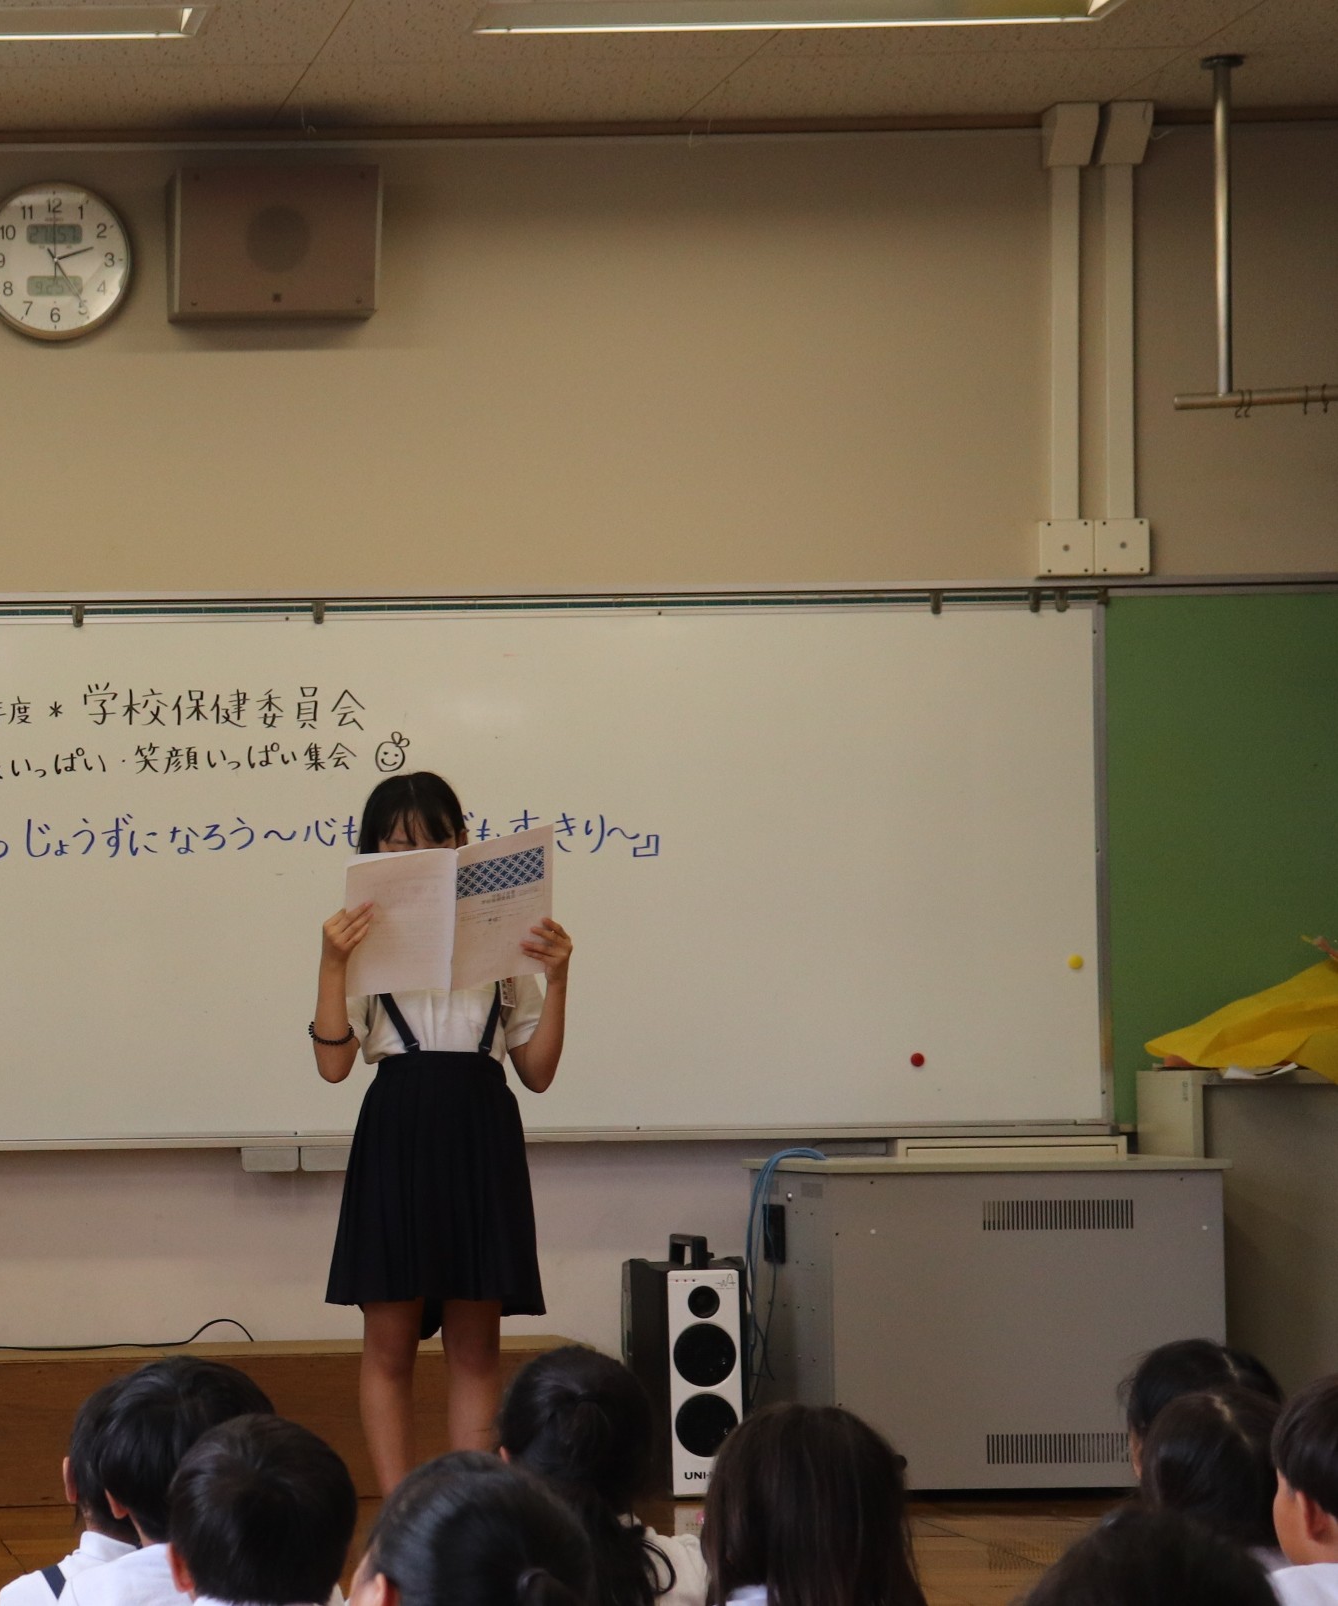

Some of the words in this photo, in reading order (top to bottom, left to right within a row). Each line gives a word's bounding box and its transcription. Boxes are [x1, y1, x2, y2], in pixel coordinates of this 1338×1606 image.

[21, 205, 34, 219] 11
[47, 198, 63, 213] 12
[78, 205, 84, 219] 1
[0, 225, 17, 240] 10
[96, 223, 108, 238] 2
[104, 252, 116, 267] 3
[2, 280, 14, 297] 8
[97, 280, 108, 295] 4
[23, 300, 34, 316] 7
[49, 307, 61, 323] 6
[78, 300, 88, 316] 5
